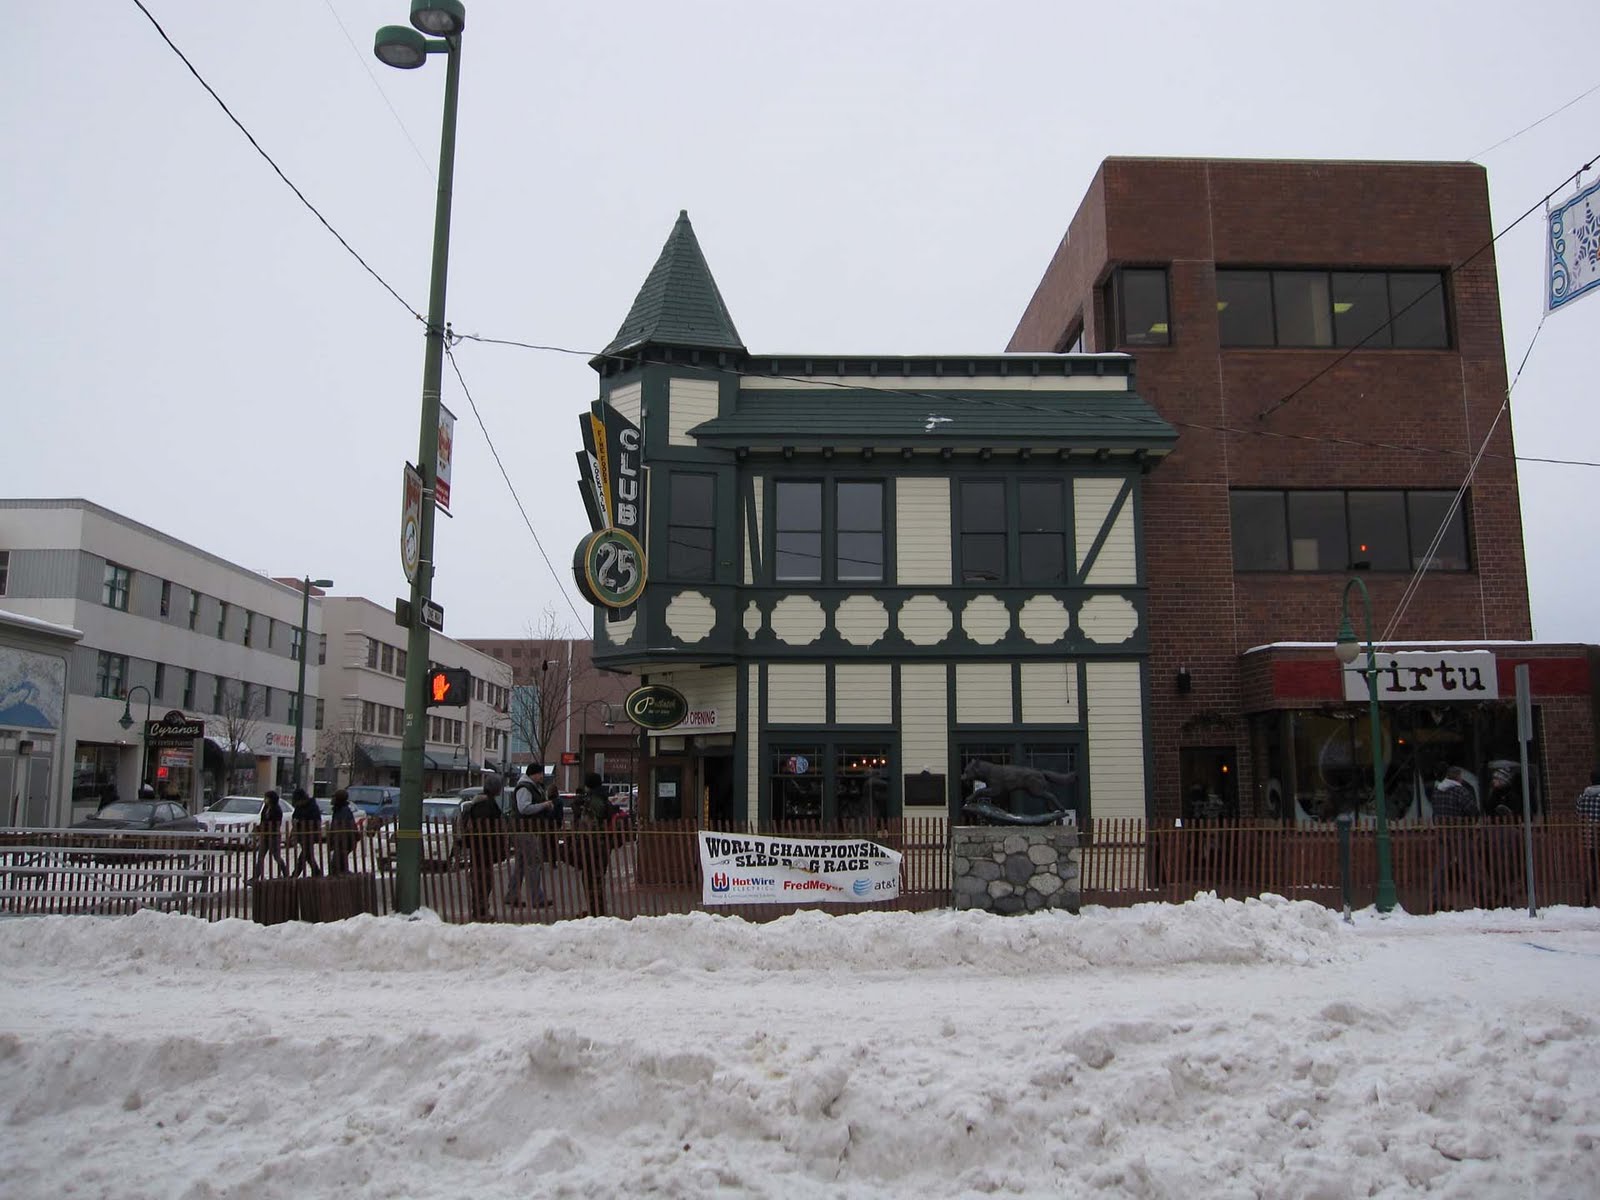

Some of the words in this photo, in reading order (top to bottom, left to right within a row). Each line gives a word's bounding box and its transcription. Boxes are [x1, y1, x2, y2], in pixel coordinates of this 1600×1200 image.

[593, 461, 606, 513] COCKTAILS
[618, 428, 640, 526] CLUB
[599, 542, 638, 594] 25
[1357, 660, 1486, 692] virtu
[690, 710, 715, 725] OPENING
[150, 722, 200, 737] Cyrano's
[705, 837, 765, 858] WORLD
[735, 854, 778, 867] SLED
[782, 858, 820, 873] DG
[824, 859, 869, 873] RACE
[732, 877, 775, 886] HotWire
[874, 879, 896, 890] at&t
